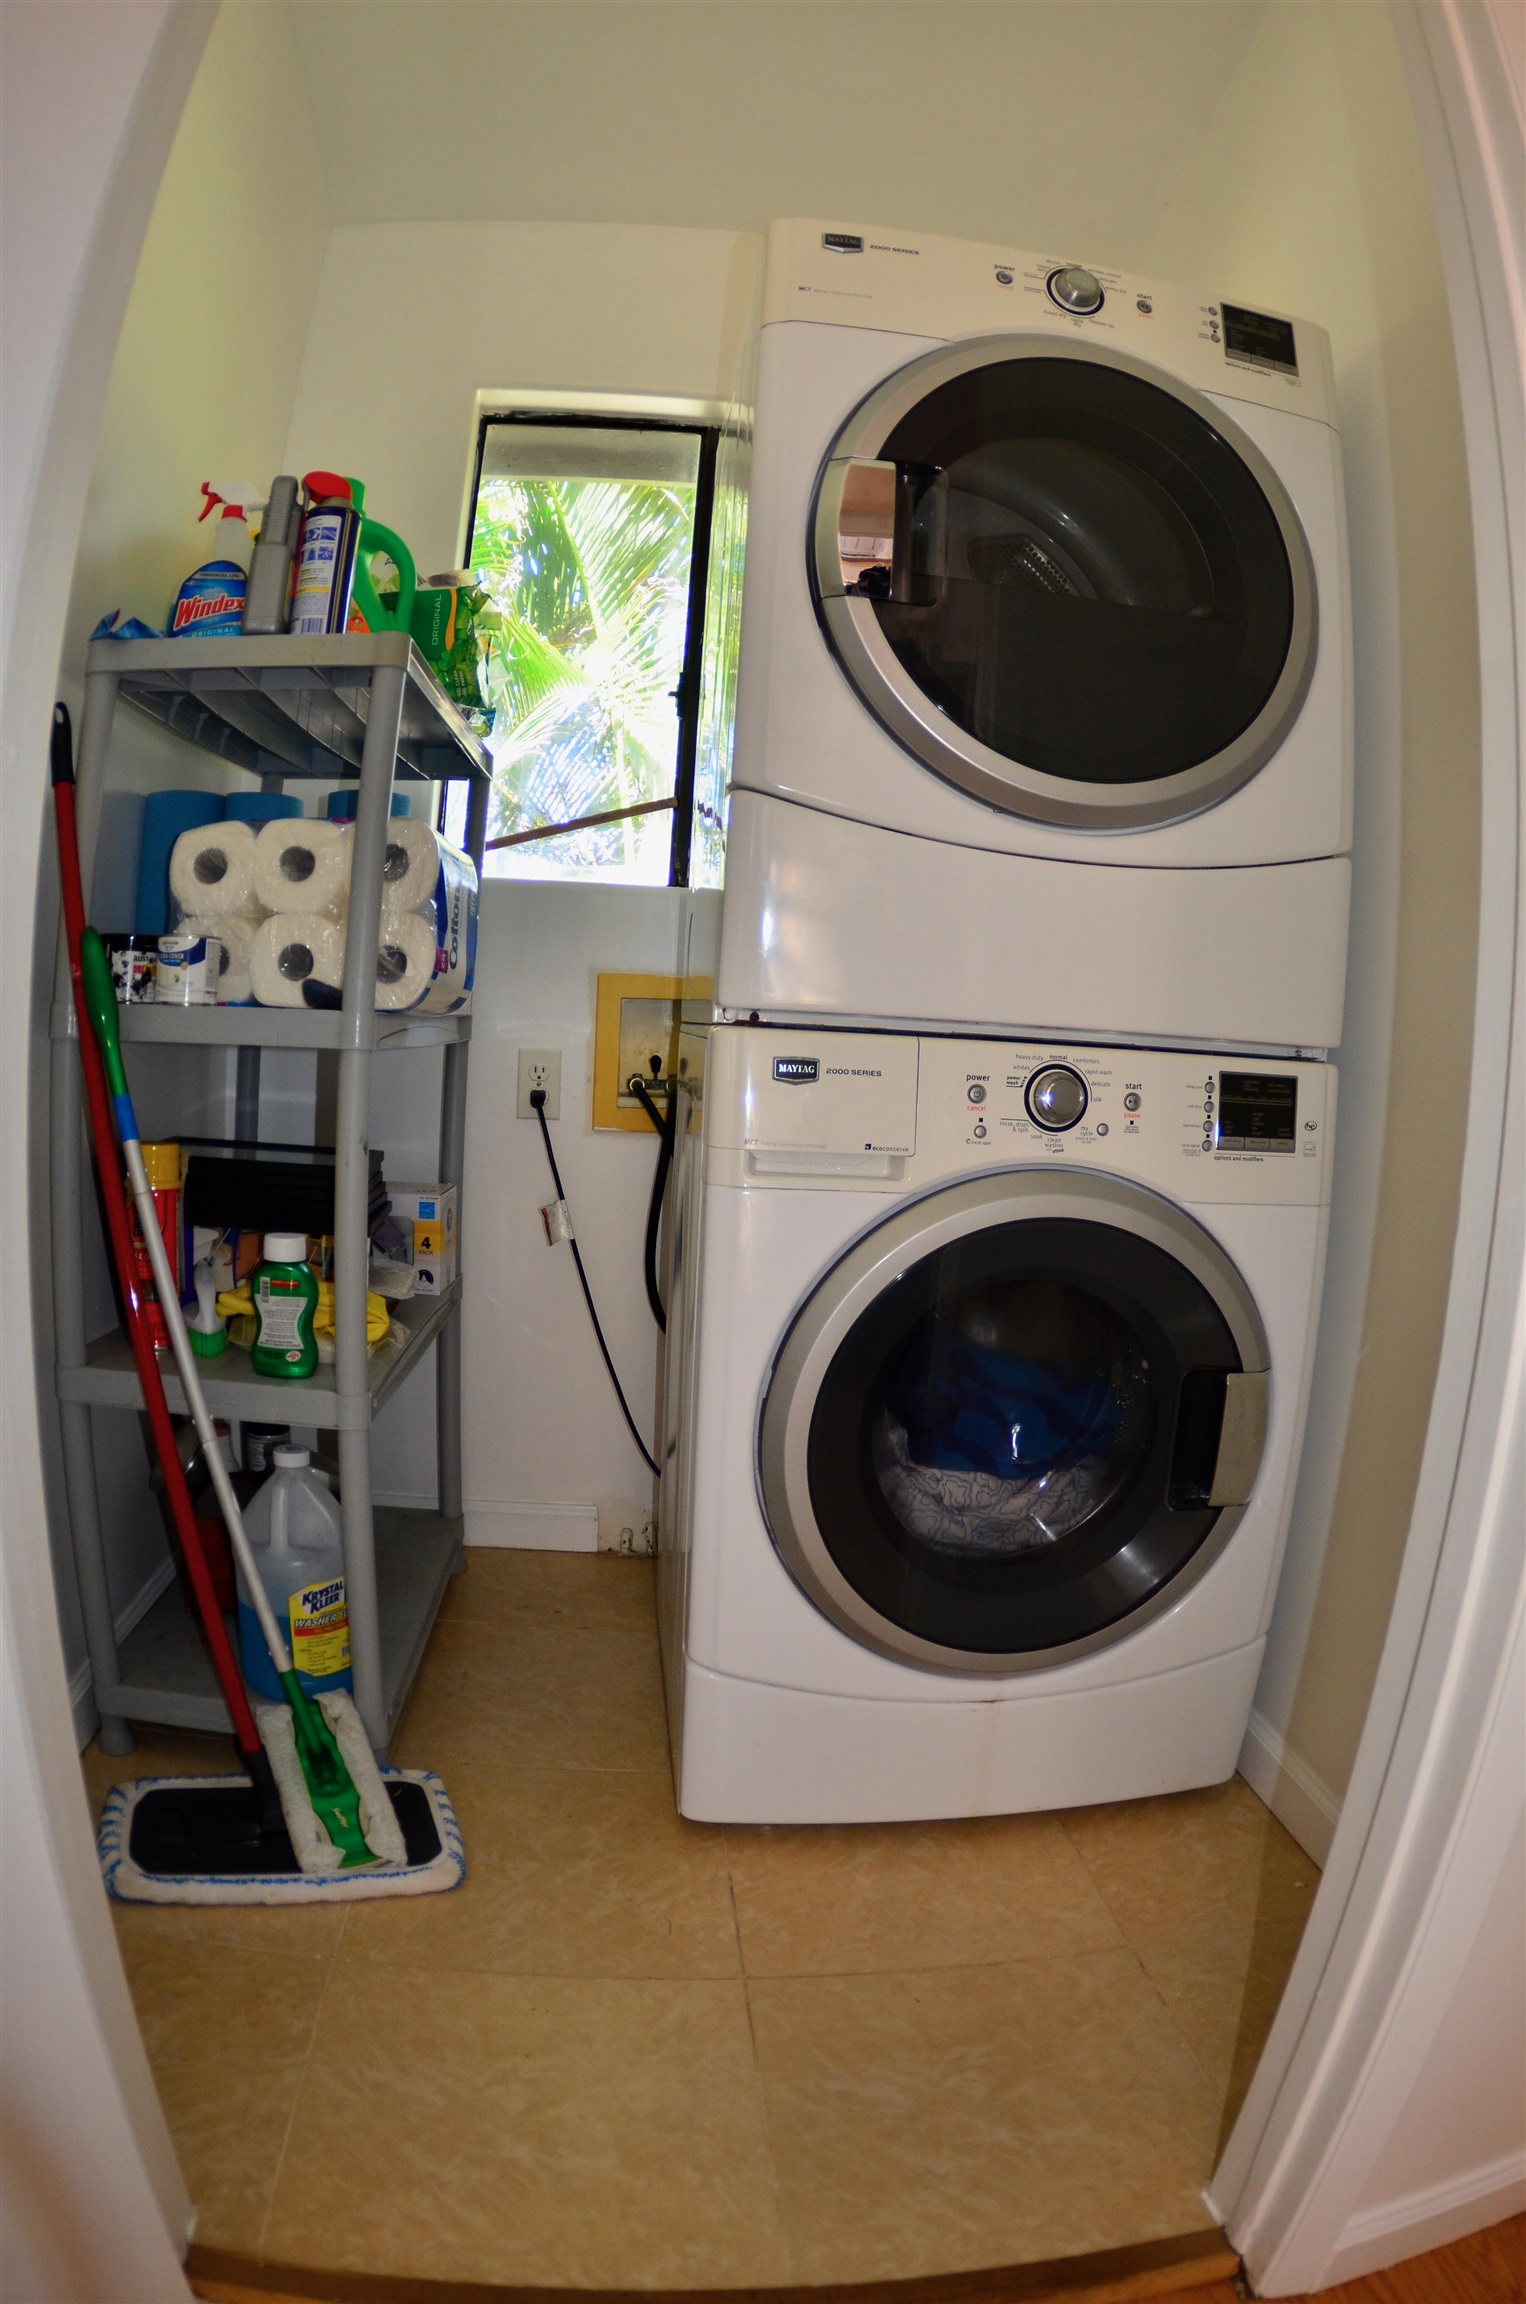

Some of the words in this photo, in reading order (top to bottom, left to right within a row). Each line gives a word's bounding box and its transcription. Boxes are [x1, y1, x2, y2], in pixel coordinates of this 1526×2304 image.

[827, 235, 860, 245] MAYTAG
[870, 244, 891, 252] 2000
[892, 247, 920, 255] SERIES
[994, 264, 1016, 272] power
[1136, 293, 1153, 301] start
[173, 593, 245, 631] Windex
[431, 594, 442, 646] ORIGINAL
[191, 628, 234, 637] ORIGINAL
[1015, 1053, 1031, 1061] heavy
[778, 1063, 816, 1074] MAYTAG
[850, 1069, 882, 1077] SERIES
[966, 1074, 991, 1082] power
[1125, 1082, 1142, 1090] start
[872, 1145, 909, 1153] ecoconserve
[421, 1236, 432, 1249] 4
[301, 1580, 344, 1607] KRYSTAL
[309, 1592, 340, 1615] KLEER
[294, 1613, 337, 1628] WASHER
